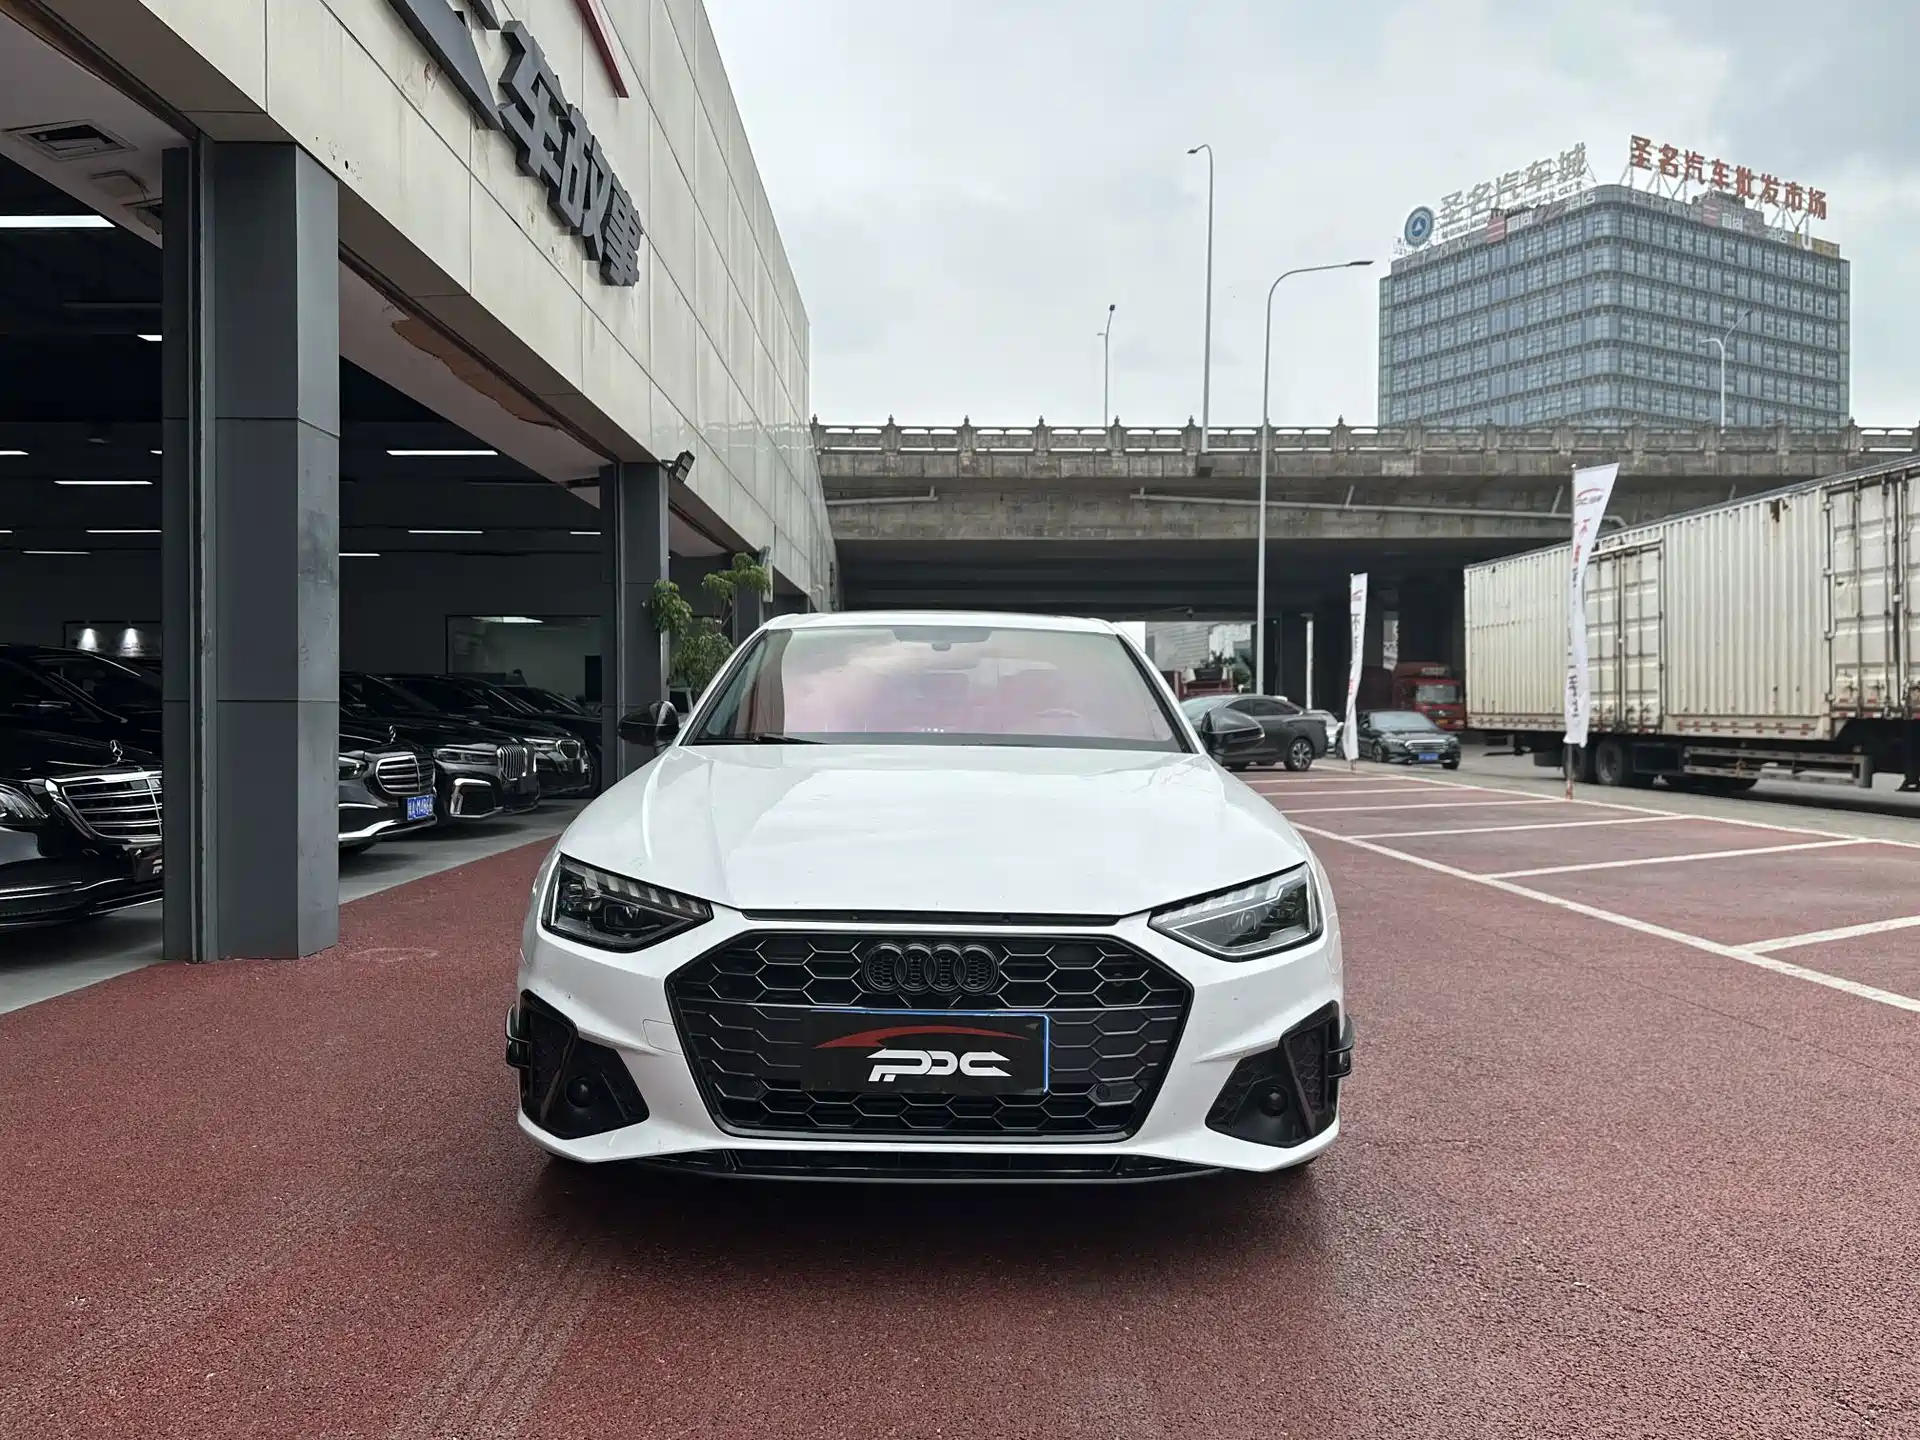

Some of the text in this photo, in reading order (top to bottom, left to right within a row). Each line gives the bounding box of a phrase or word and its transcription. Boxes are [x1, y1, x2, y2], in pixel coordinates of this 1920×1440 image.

[1439, 142, 1587, 222] 圣名汽车城
[1630, 134, 1828, 221] 圣名汽车批发市场
